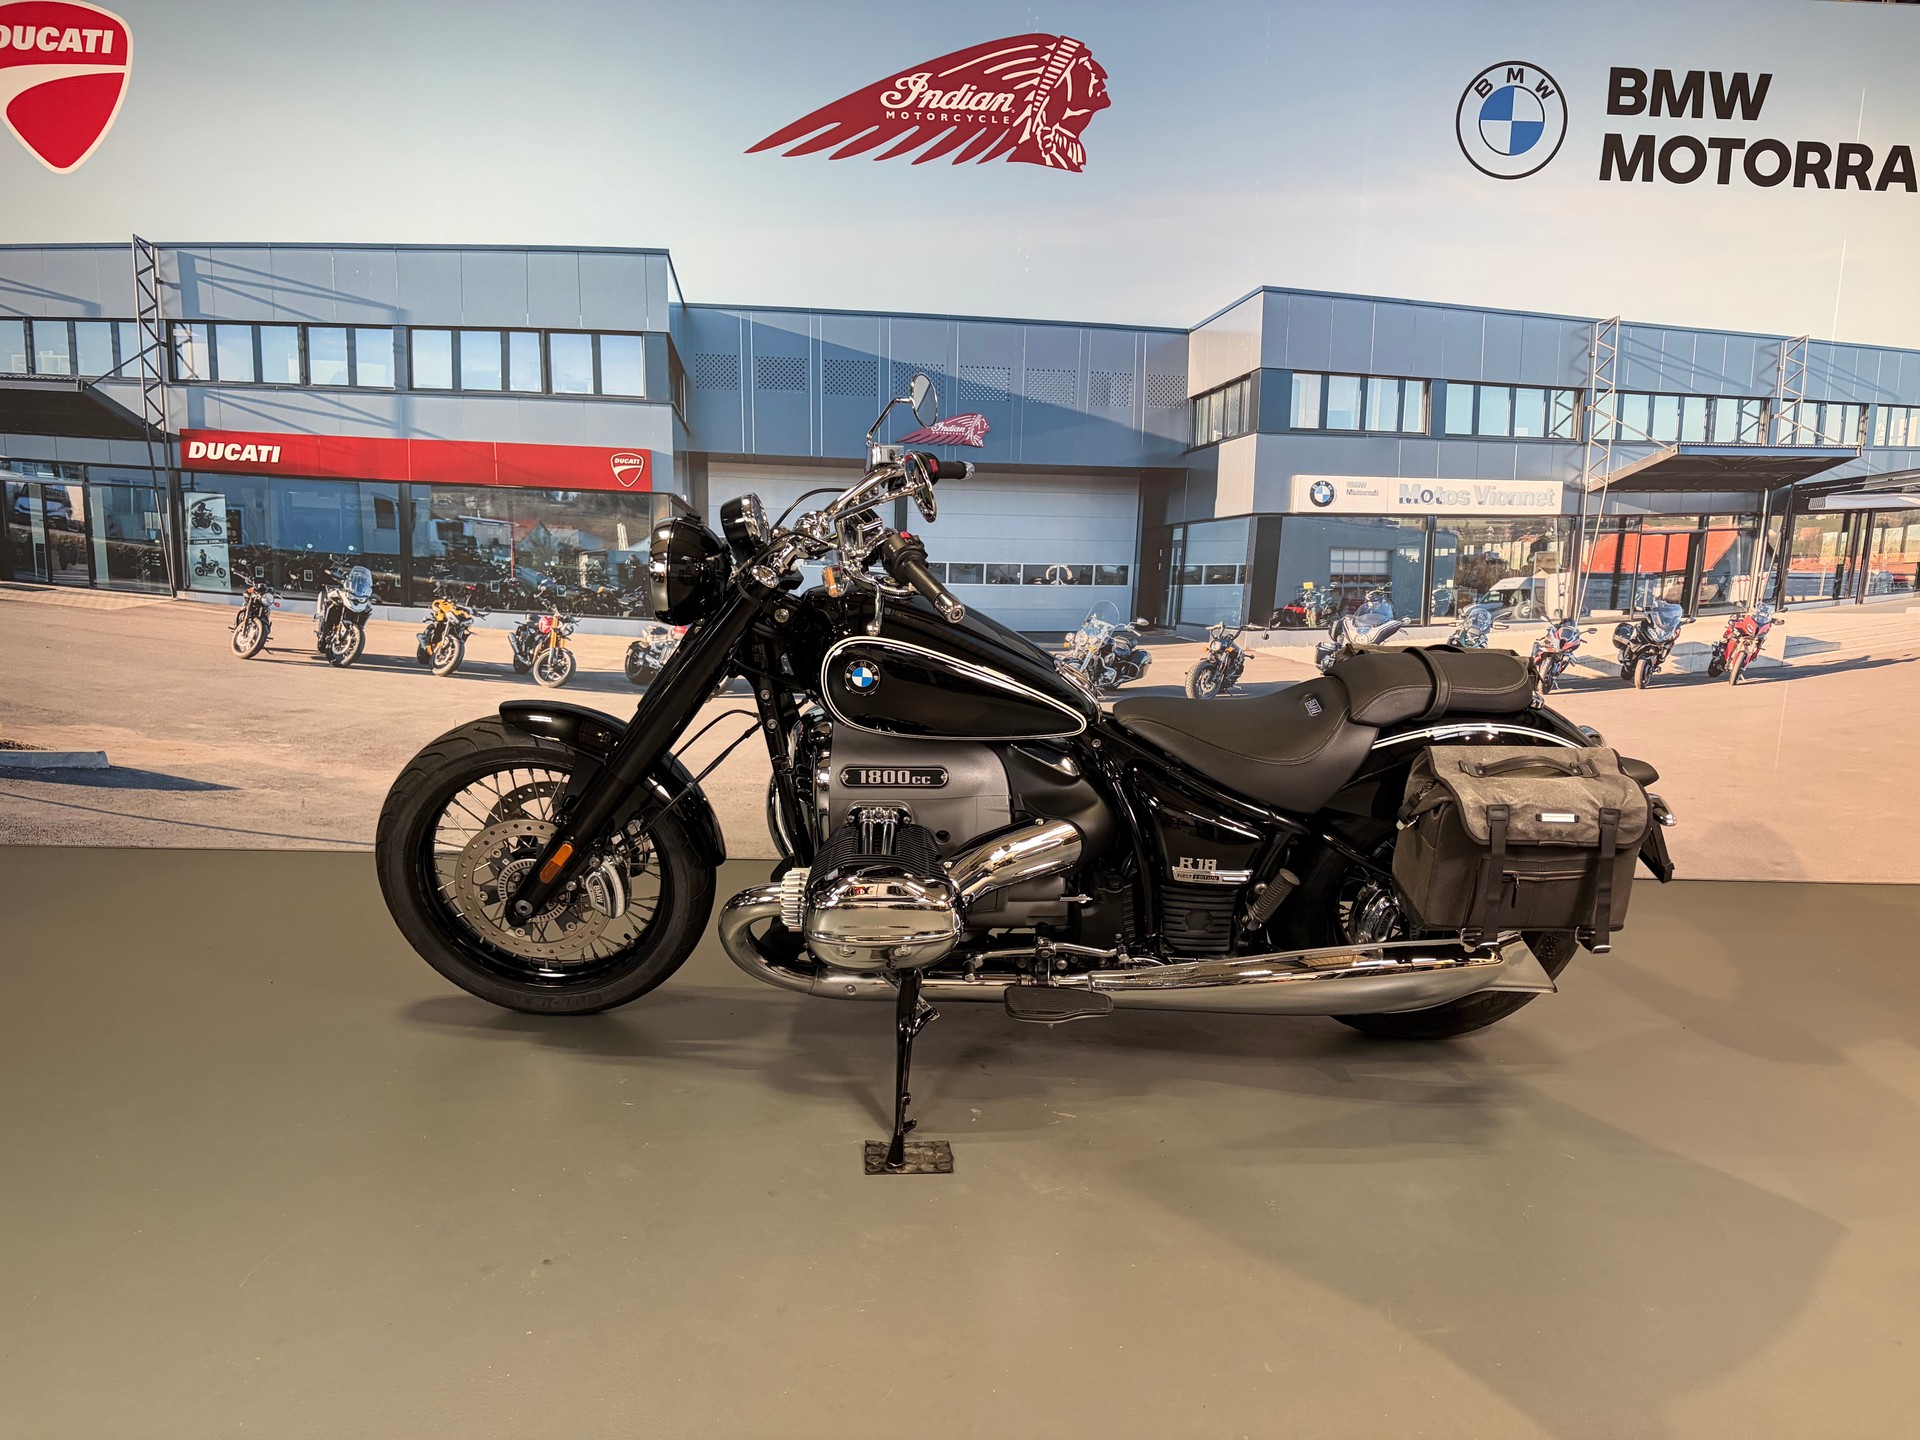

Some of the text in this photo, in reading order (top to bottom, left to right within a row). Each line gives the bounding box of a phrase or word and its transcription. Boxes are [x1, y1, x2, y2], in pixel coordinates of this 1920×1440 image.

[880, 72, 1015, 113] Indian
[1474, 67, 1556, 100] BMW
[1606, 66, 1773, 121] BMW
[886, 111, 1010, 124] MOTORCYCLE
[1599, 133, 1918, 193] MOTORRA
[931, 422, 966, 432] Indian
[188, 441, 281, 463] DUCATI
[1398, 483, 1555, 506] Motos Vionnet
[849, 661, 877, 672] BMW
[859, 770, 931, 784] 1800cc
[593, 885, 604, 903] BMW
